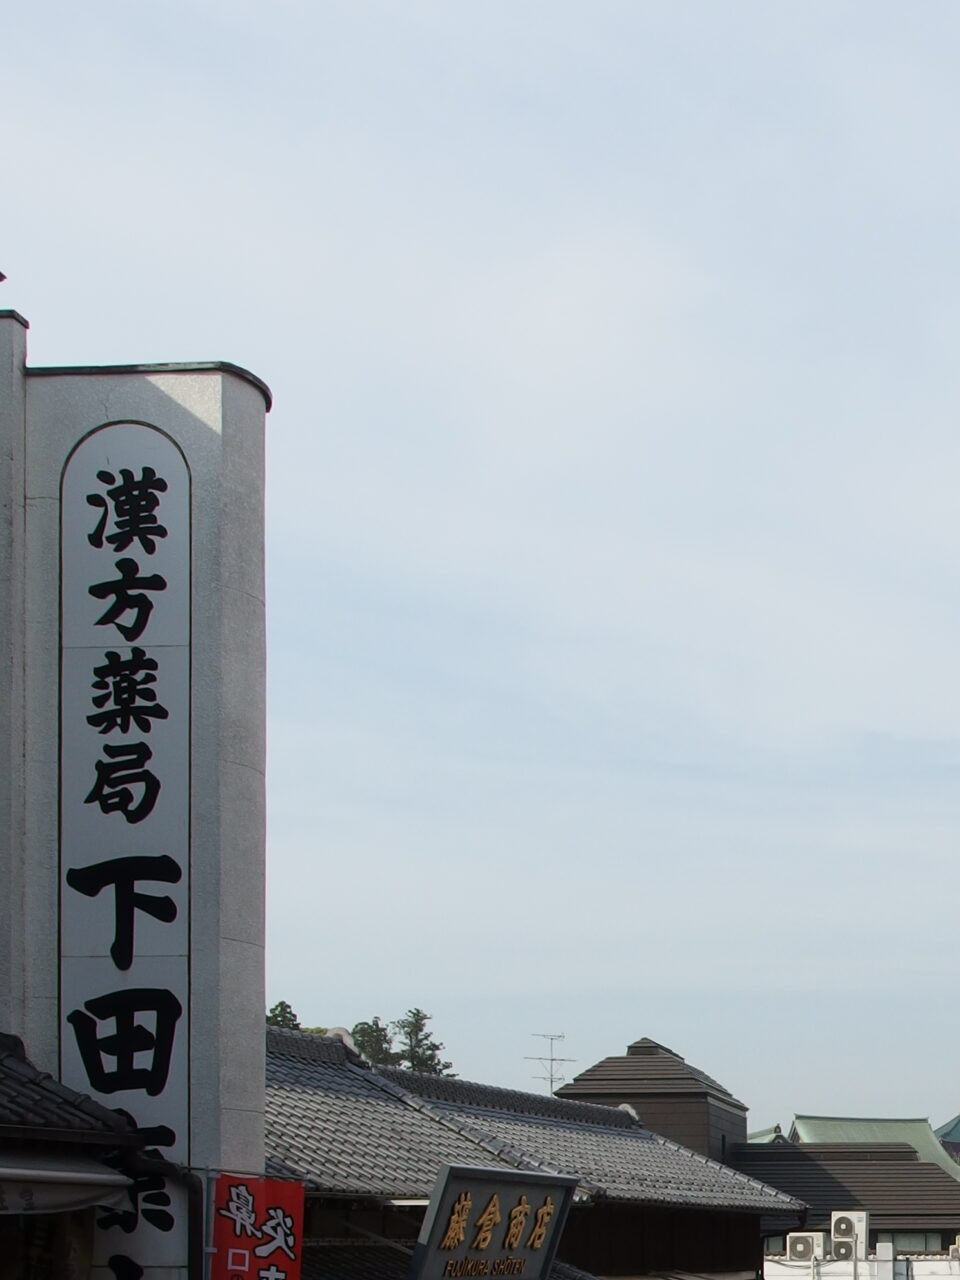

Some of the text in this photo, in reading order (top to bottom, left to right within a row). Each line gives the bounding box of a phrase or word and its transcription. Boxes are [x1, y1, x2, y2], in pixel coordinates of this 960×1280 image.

[86, 466, 169, 826] 漢方薬局
[439, 1191, 556, 1251] 藤倉商店
[443, 1257, 490, 1278] FUJIKURA
